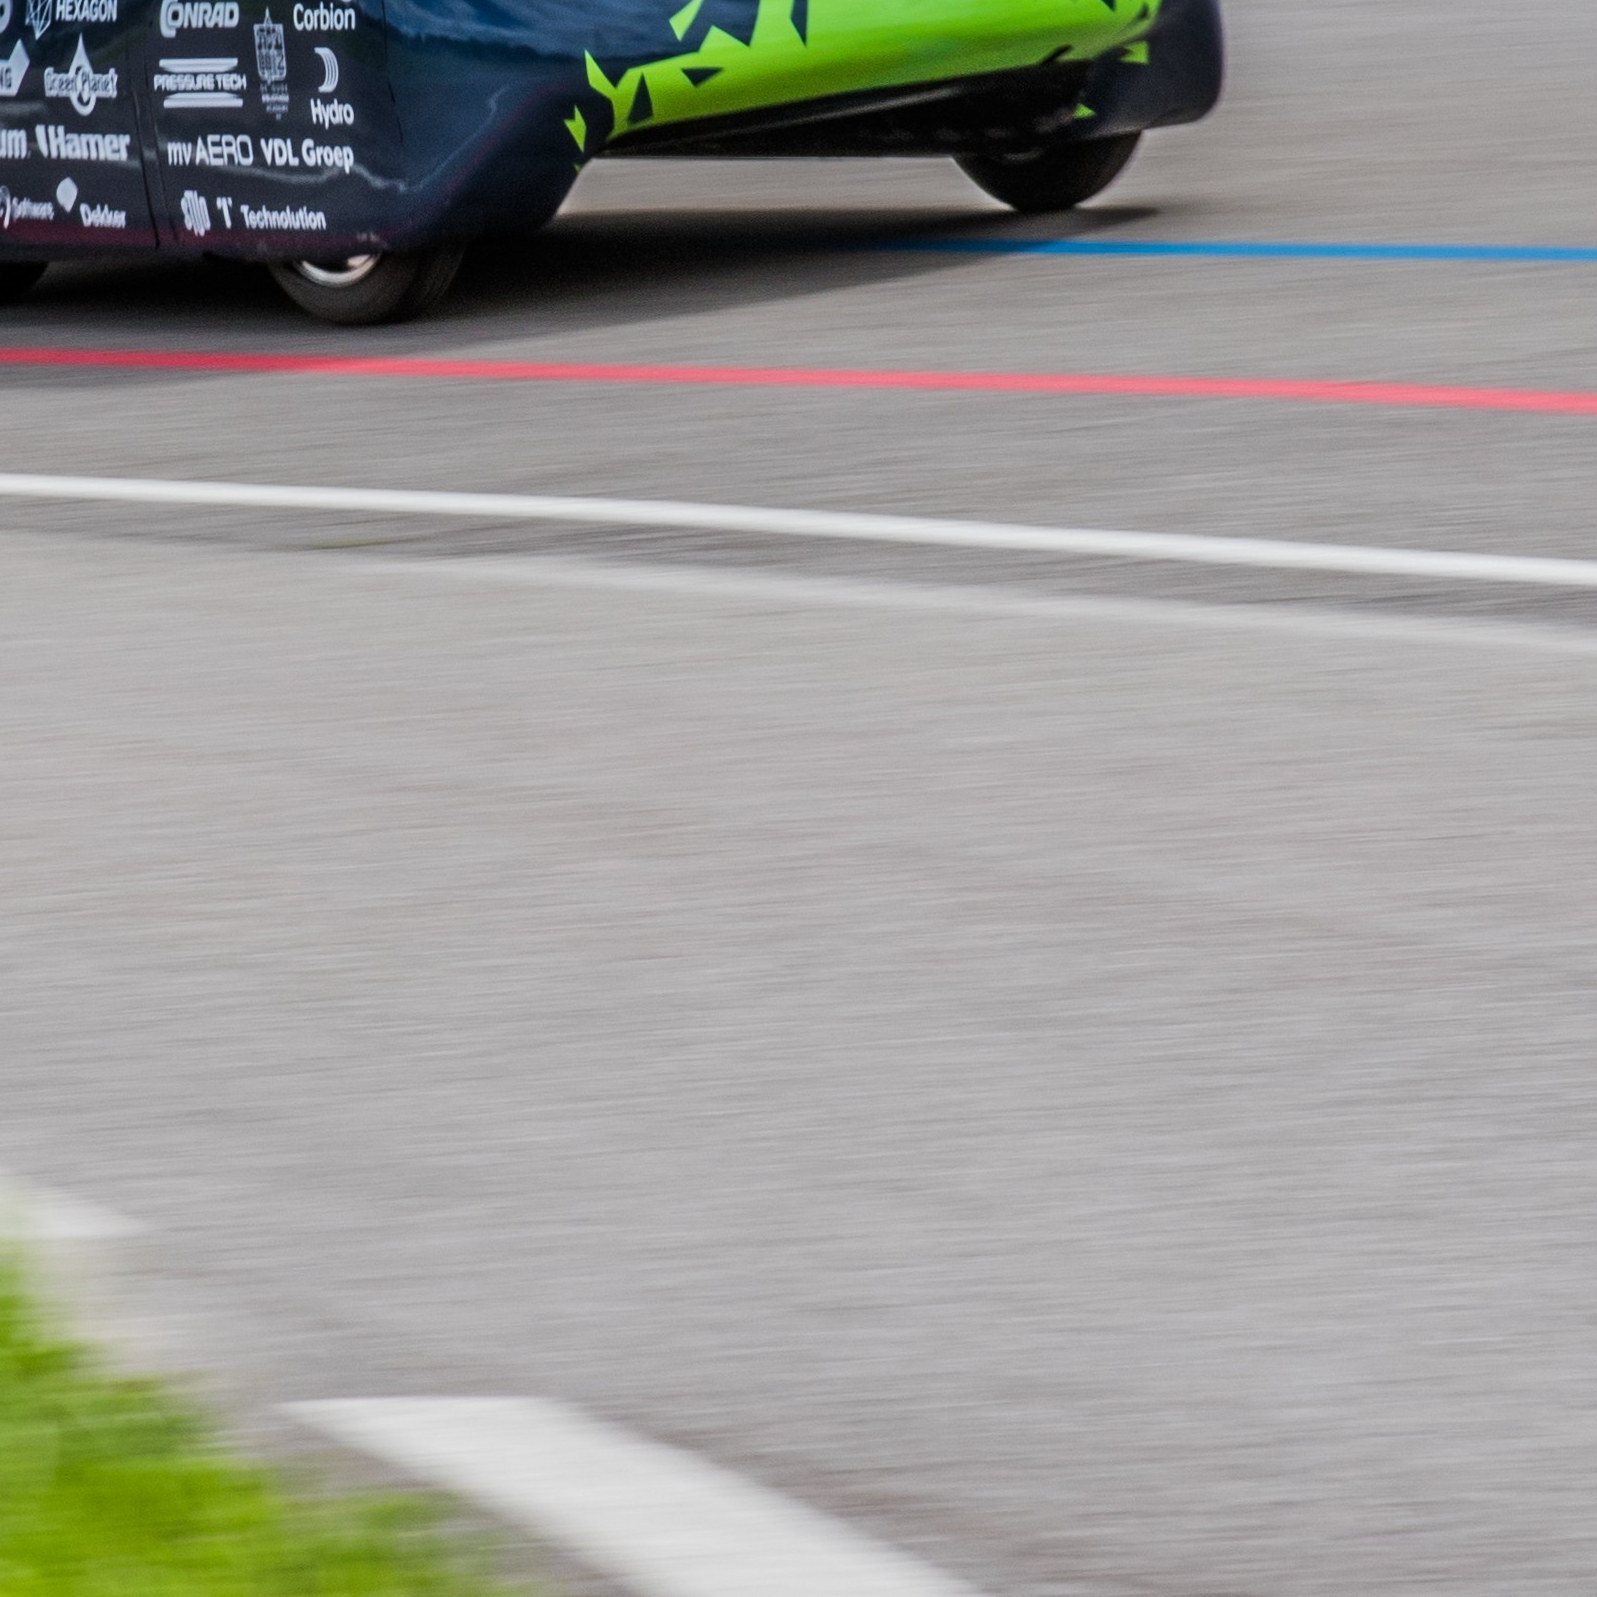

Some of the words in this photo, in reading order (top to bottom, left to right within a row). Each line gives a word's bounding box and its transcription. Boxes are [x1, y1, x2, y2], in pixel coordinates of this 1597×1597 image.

[293, 1, 355, 31] Corbion
[153, 74, 215, 92] PRESSURE
[215, 74, 247, 91] TECH
[310, 98, 354, 130] Hydro
[48, 125, 131, 162] Hamer
[195, 134, 253, 166] AERO
[260, 138, 299, 166] VDL
[302, 138, 354, 175] Groep
[240, 204, 327, 230] Technolution
